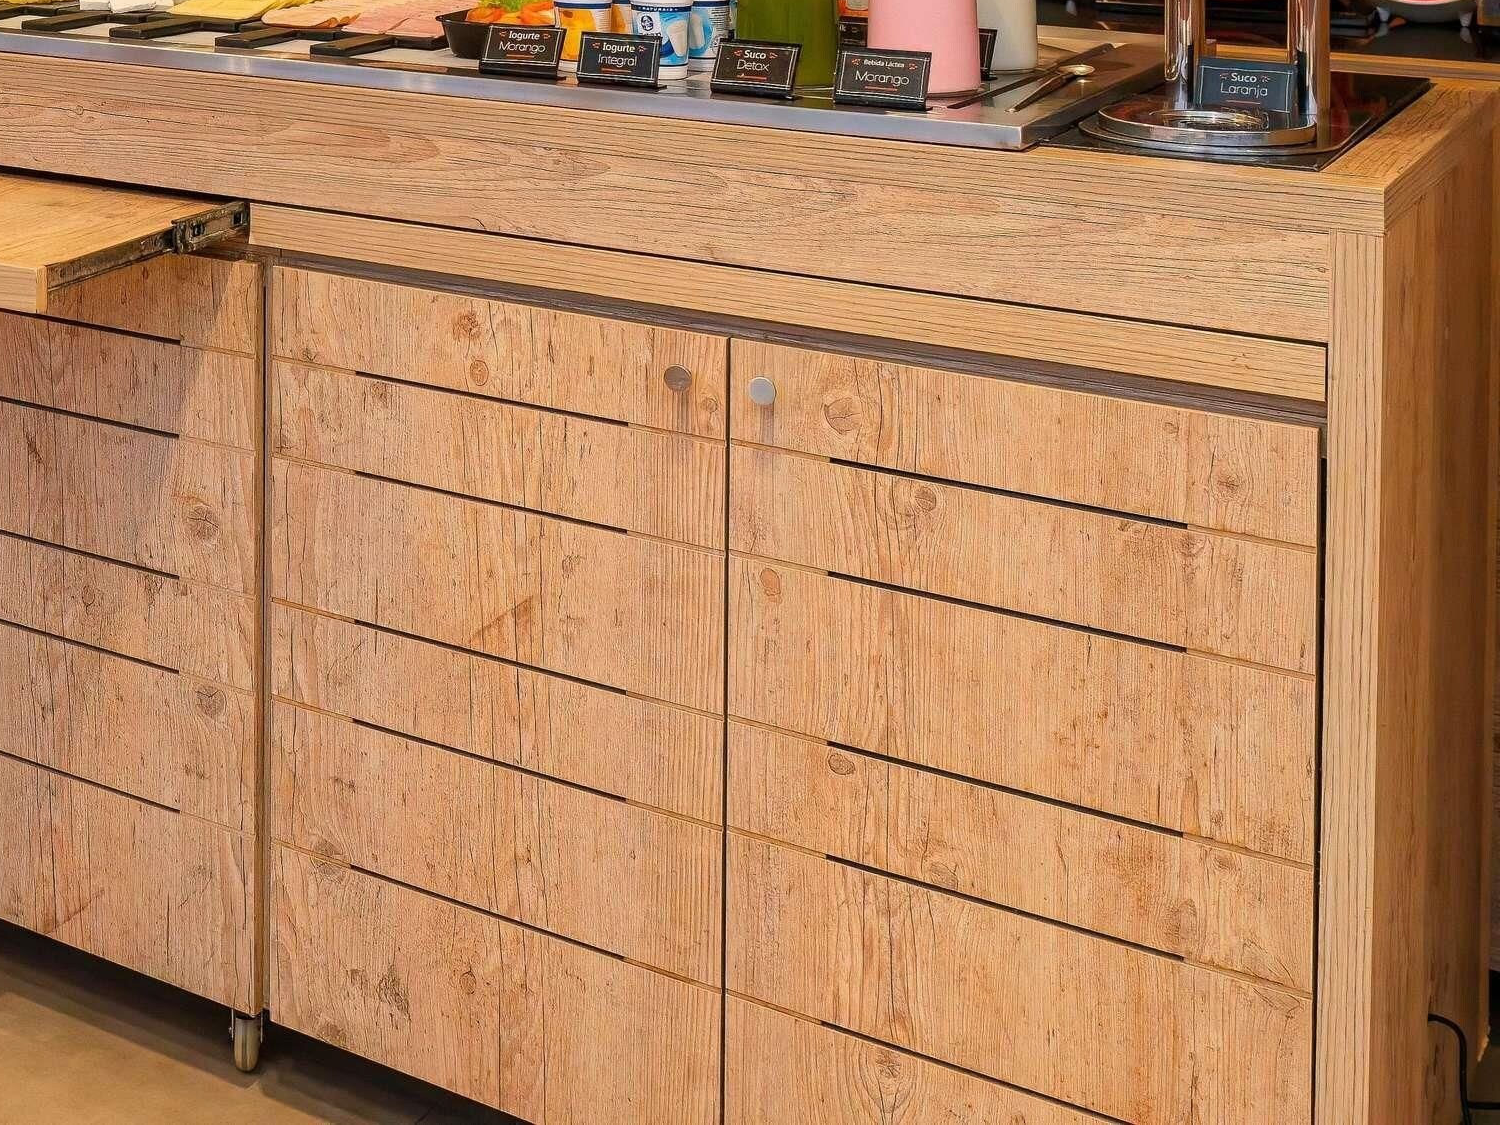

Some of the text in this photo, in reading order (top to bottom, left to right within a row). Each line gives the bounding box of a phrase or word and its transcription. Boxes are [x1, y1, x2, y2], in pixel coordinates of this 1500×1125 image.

[508, 30, 540, 41] Iogurte
[498, 41, 546, 55] Morango
[602, 42, 636, 54] Iogurte
[597, 53, 638, 68] Integral
[743, 49, 767, 60] Suco
[736, 59, 770, 72] Detox
[863, 58, 885, 67] Bebida
[855, 70, 910, 87] Morango
[1230, 72, 1257, 83] Suco
[1220, 82, 1268, 98] Laranja
